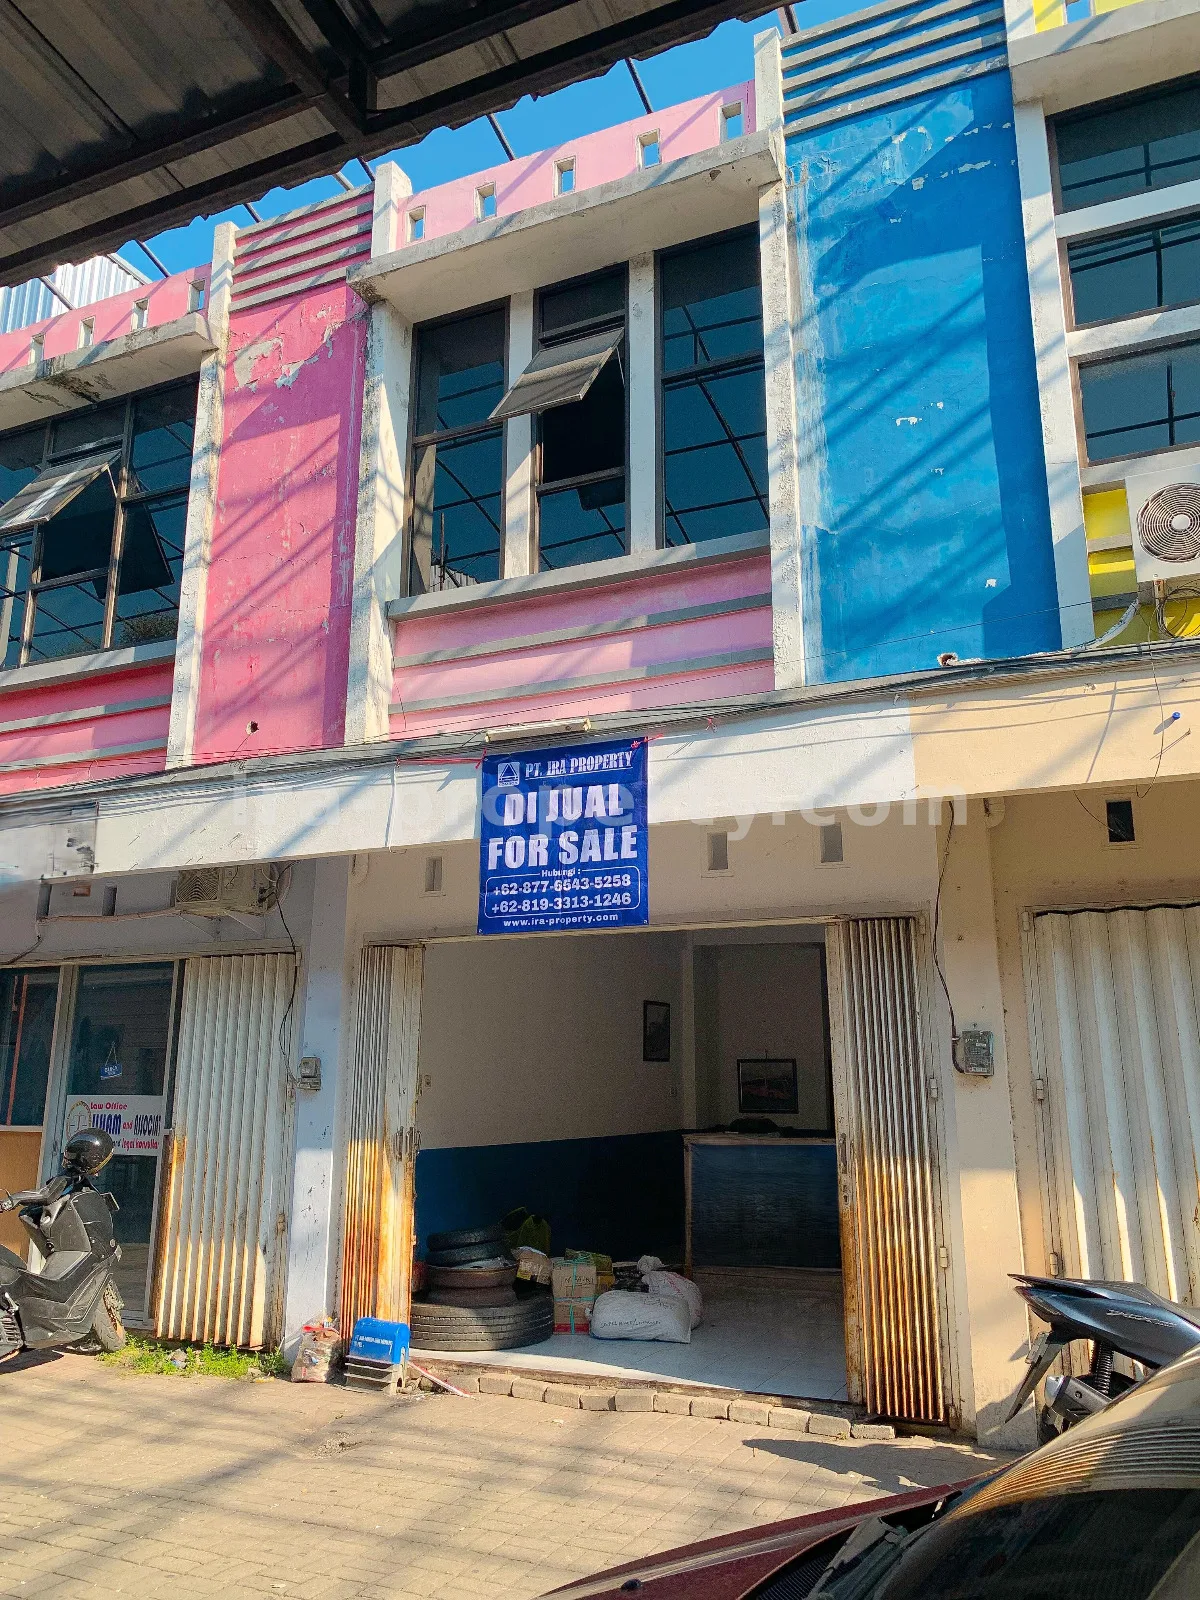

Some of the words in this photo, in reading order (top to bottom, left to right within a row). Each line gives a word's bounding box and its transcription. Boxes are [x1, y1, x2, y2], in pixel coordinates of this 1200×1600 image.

[525, 763, 543, 778] PT.
[547, 759, 567, 776] IRA
[570, 750, 633, 773] PROPERTY
[503, 791, 538, 826] DI
[546, 783, 624, 822] JUAL
[487, 833, 549, 871] FOR
[558, 825, 638, 865] SALE
[541, 868, 576, 878] Hubungi
[493, 874, 632, 896] +62-877-6543-5258
[491, 892, 632, 914] +62-819-3313-1246
[503, 913, 619, 927] www.ira-property.com
[90, 1102, 104, 1110] Law
[105, 1102, 128, 1111] Office
